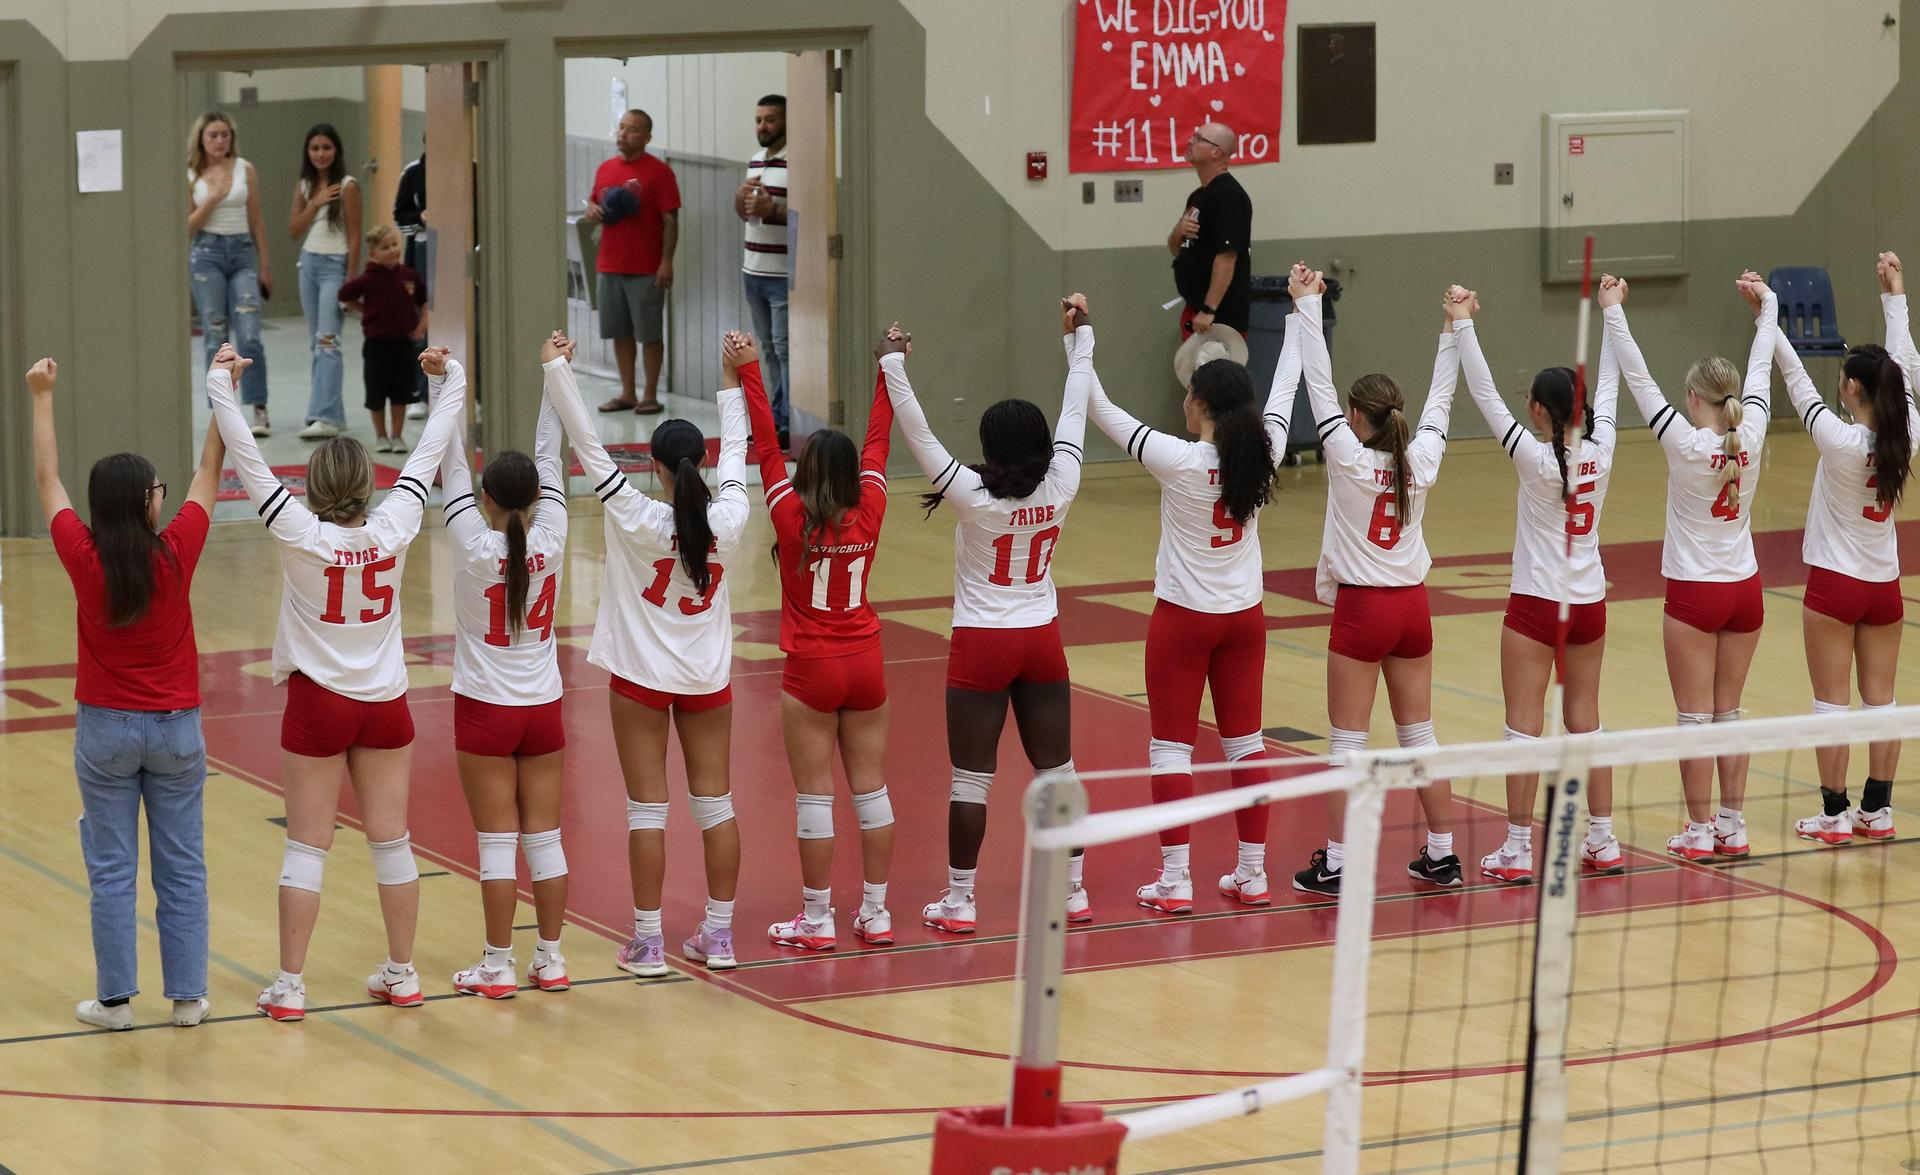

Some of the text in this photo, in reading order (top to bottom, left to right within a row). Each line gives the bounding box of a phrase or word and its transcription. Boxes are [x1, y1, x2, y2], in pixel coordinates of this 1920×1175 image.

[1095, 0, 1265, 36] WE DIG YOU
[1131, 41, 1229, 90] EMMA
[1092, 114, 1269, 163] #11 Lro
[1009, 505, 1055, 526] TRIBE
[1565, 481, 1595, 535] 5
[1711, 478, 1740, 522] 4
[498, 553, 546, 576] TBE
[988, 525, 1060, 586] 10
[320, 556, 396, 625] 15
[808, 555, 867, 612] 11
[484, 573, 557, 647] 14
